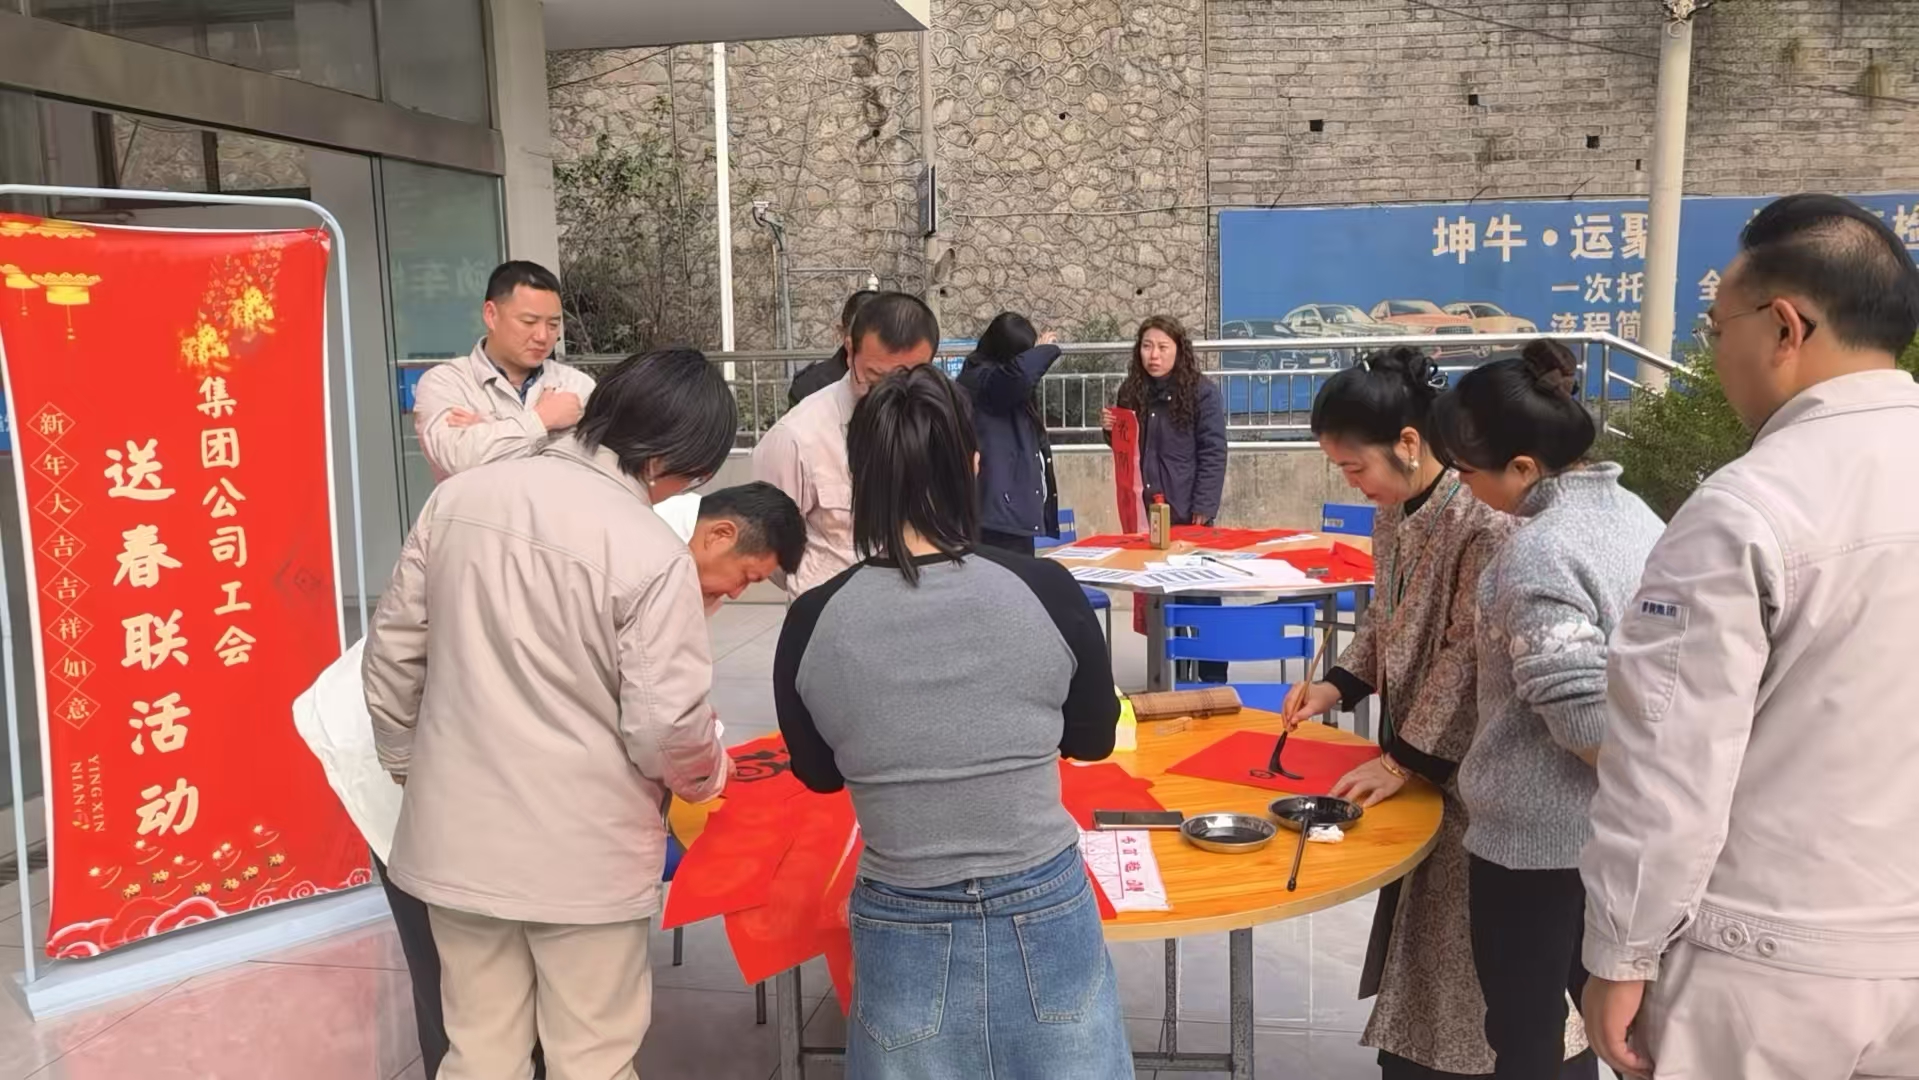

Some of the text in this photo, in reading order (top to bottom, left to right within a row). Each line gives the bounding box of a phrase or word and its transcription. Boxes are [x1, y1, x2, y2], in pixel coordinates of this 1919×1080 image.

[1551, 272, 1645, 303] 一次托
[1551, 311, 1677, 342] 流程简
[38, 411, 91, 721] 新年大吉吉祥如意
[196, 376, 256, 667] 集团公司工会
[104, 438, 200, 836] 送春联活动
[70, 761, 86, 805] NIAN
